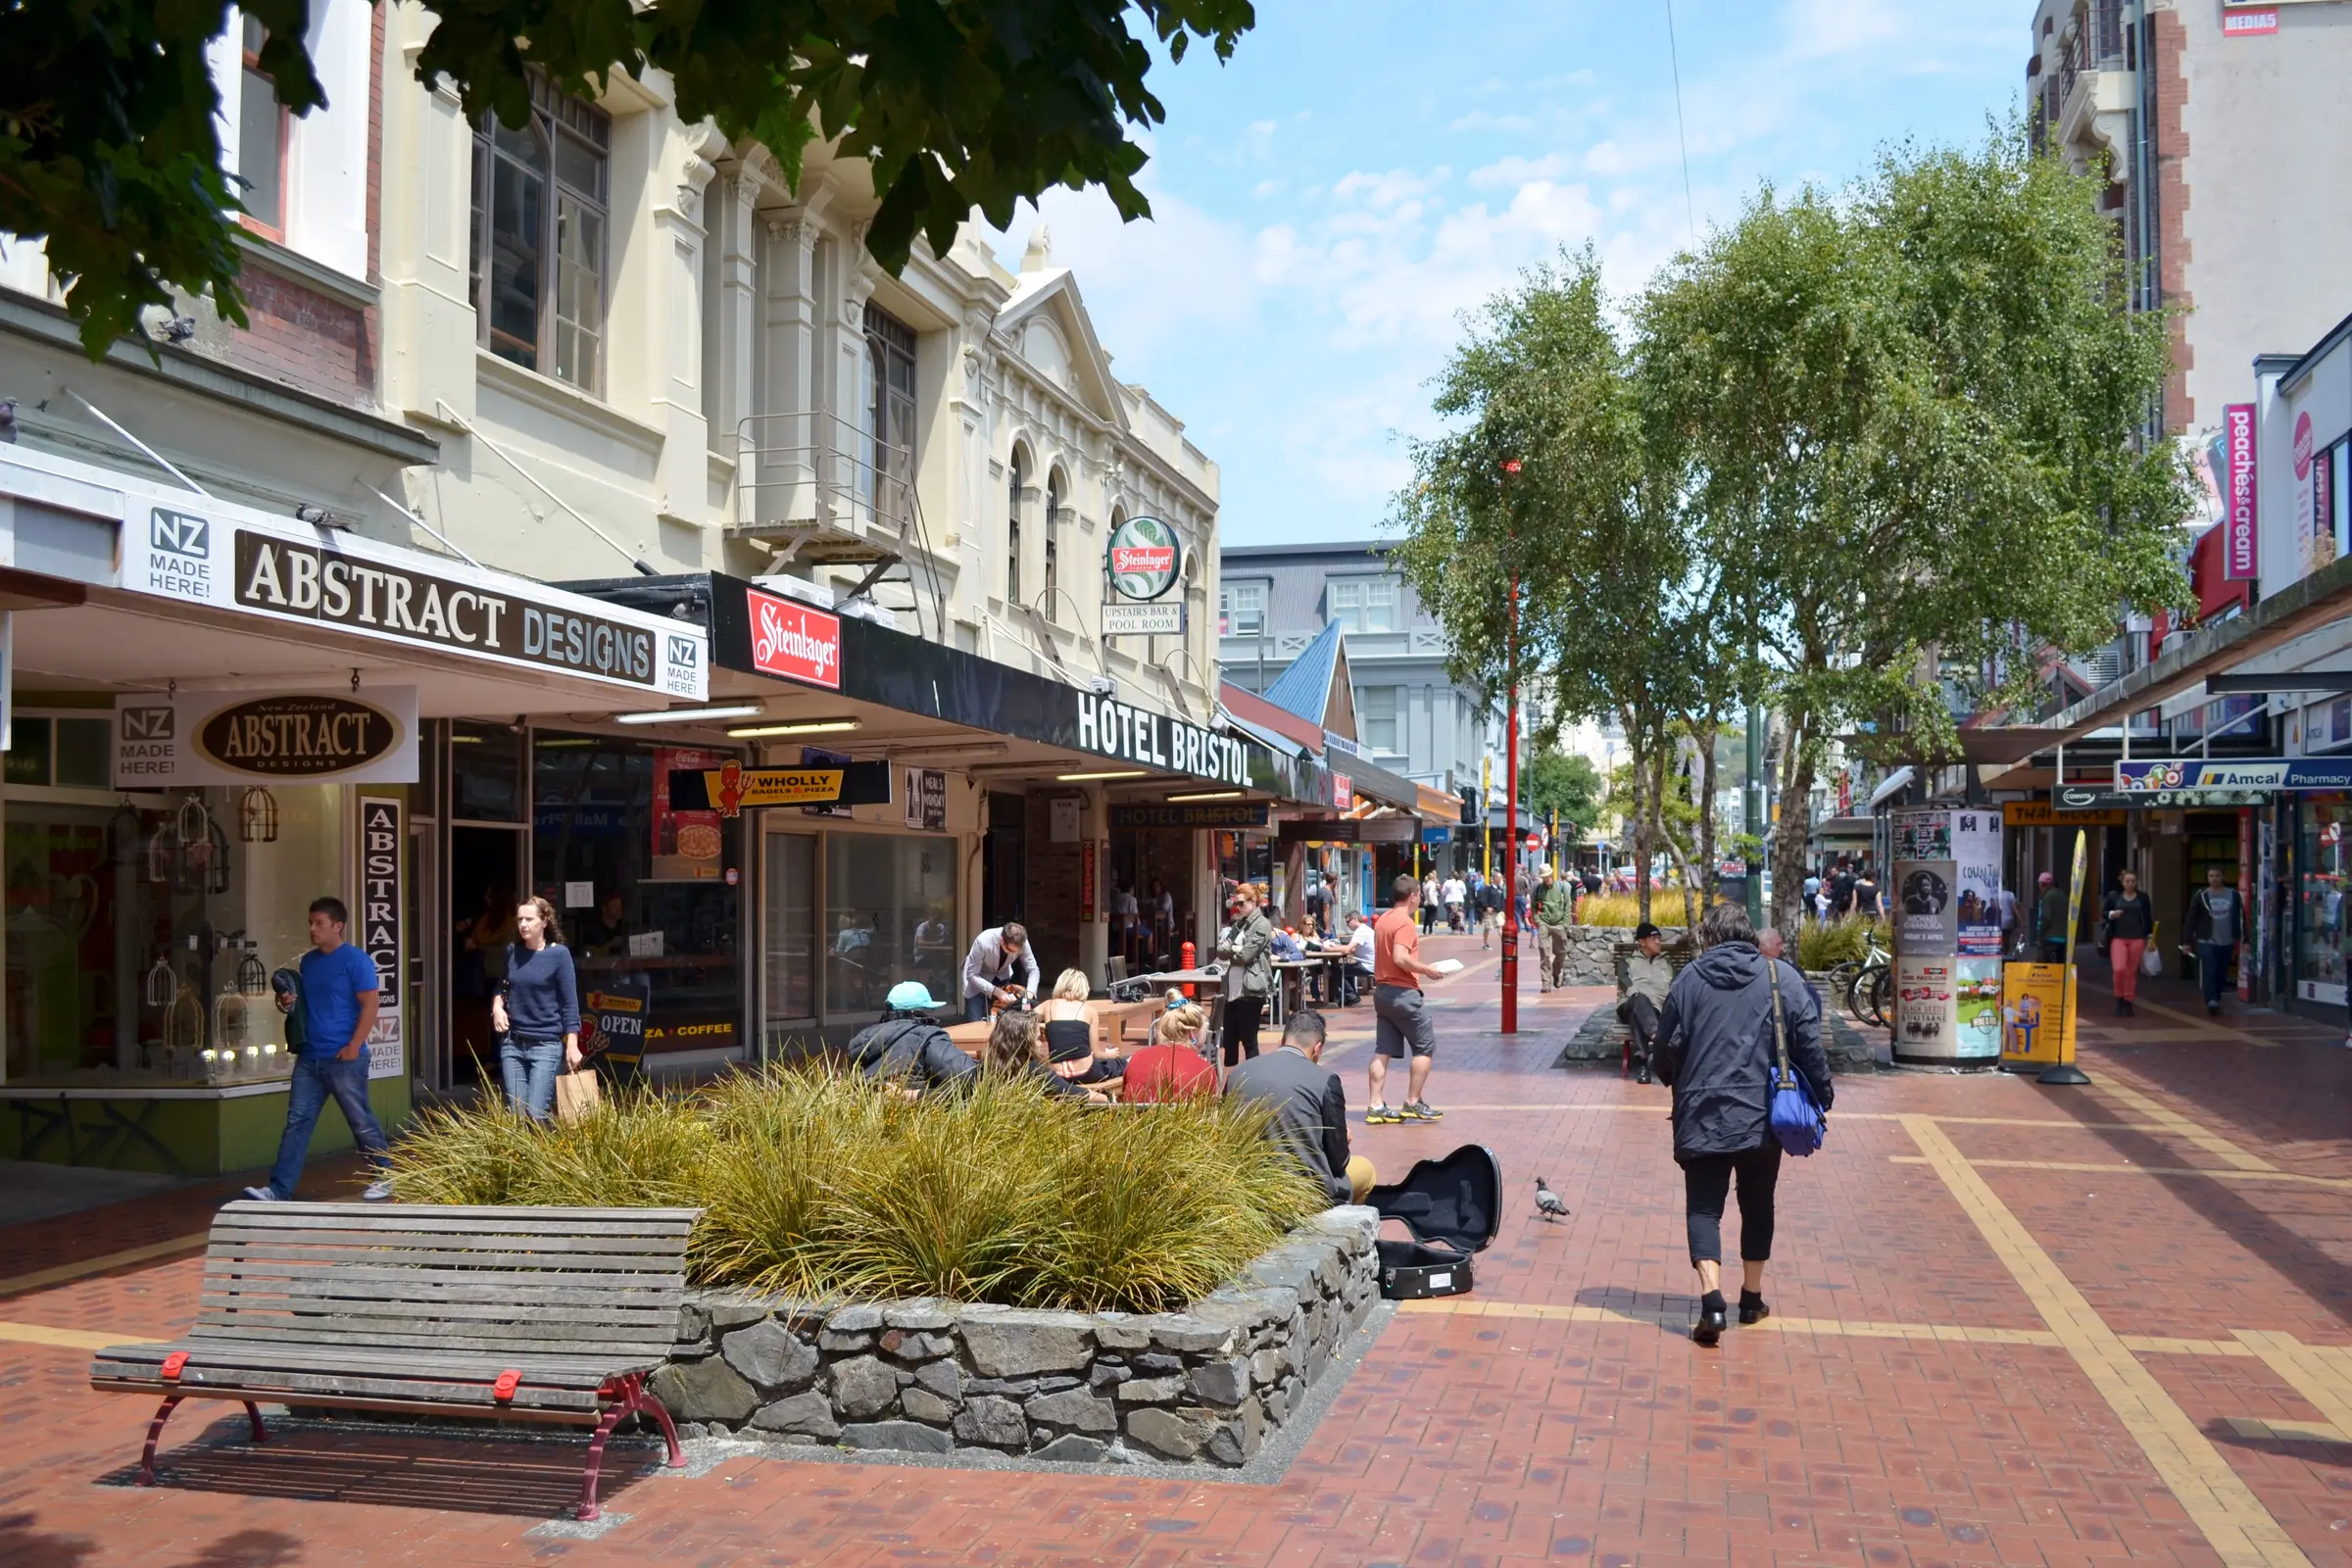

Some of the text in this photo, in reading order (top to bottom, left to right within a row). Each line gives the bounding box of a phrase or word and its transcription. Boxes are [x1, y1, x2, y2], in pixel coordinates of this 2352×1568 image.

[2226, 14, 2277, 30] MEDIA5
[154, 515, 206, 555] NZ
[150, 554, 210, 579] MADE
[1115, 549, 1170, 569] Steinlager
[150, 572, 210, 598] HERE!
[245, 543, 650, 678] ABSTRACT DESIGNS
[1105, 607, 1178, 616] UPSTAIRS BAR &
[1108, 619, 1174, 630] POOL ROOM
[759, 601, 837, 678] Steinlager
[668, 637, 696, 666] NZ
[667, 667, 697, 683] MADE
[667, 679, 697, 695] HERE!
[259, 702, 336, 712] New Zealand
[124, 710, 171, 737] NZ
[224, 712, 370, 758] ABSTRACT
[1078, 691, 1253, 787] HOTEL BRISTOL
[121, 745, 174, 759] MADE
[121, 760, 174, 774] HERE!
[257, 760, 337, 768] DESIGNS
[758, 775, 830, 787] WHOLLY
[2120, 764, 2181, 790] LOTTO
[2228, 772, 2351, 786] Amcal Pharmacy
[1119, 808, 1258, 824] HOTEL BRISTOL
[2015, 807, 2051, 821] THAI
[602, 1014, 643, 1036] OPEN
[677, 1023, 733, 1036] COFFEE
